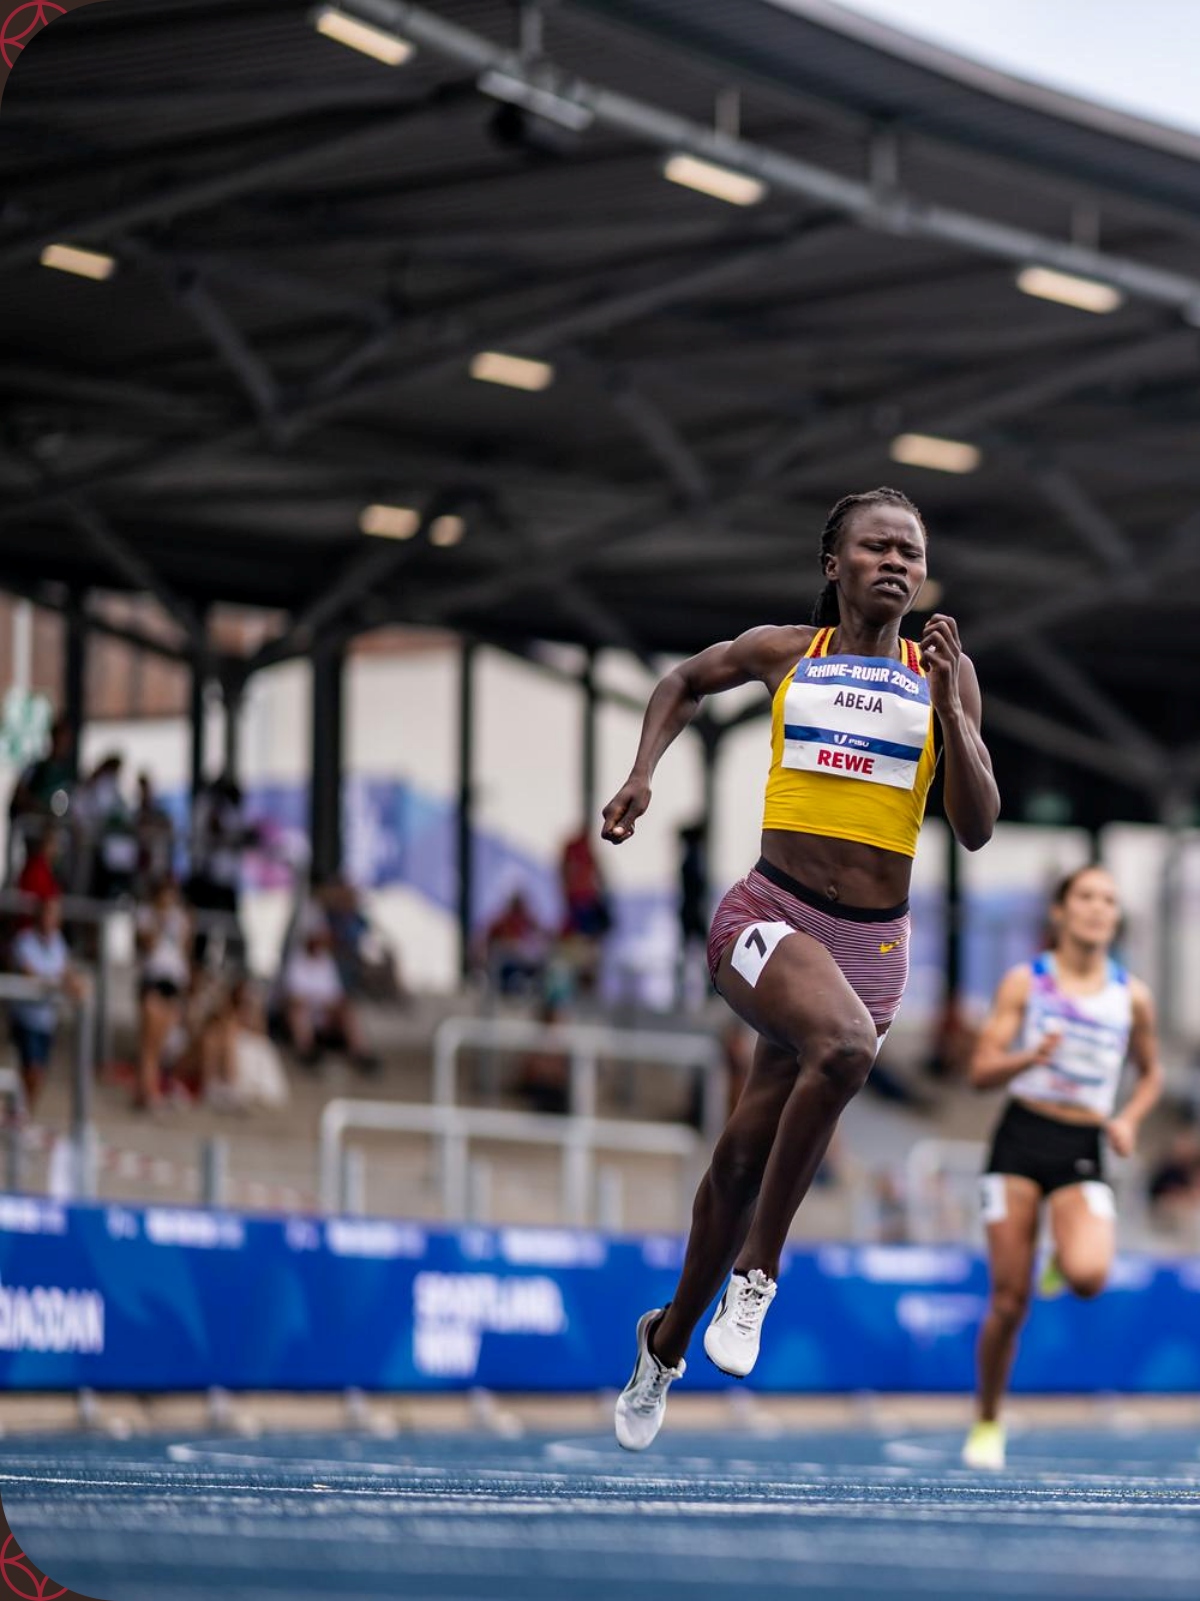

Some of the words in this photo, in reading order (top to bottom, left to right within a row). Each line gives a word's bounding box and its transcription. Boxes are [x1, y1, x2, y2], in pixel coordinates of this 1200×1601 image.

[807, 664, 889, 683] RHINE-RUHR
[833, 691, 883, 713] ABEJA
[817, 749, 875, 775] REWE
[744, 927, 768, 959] 7
